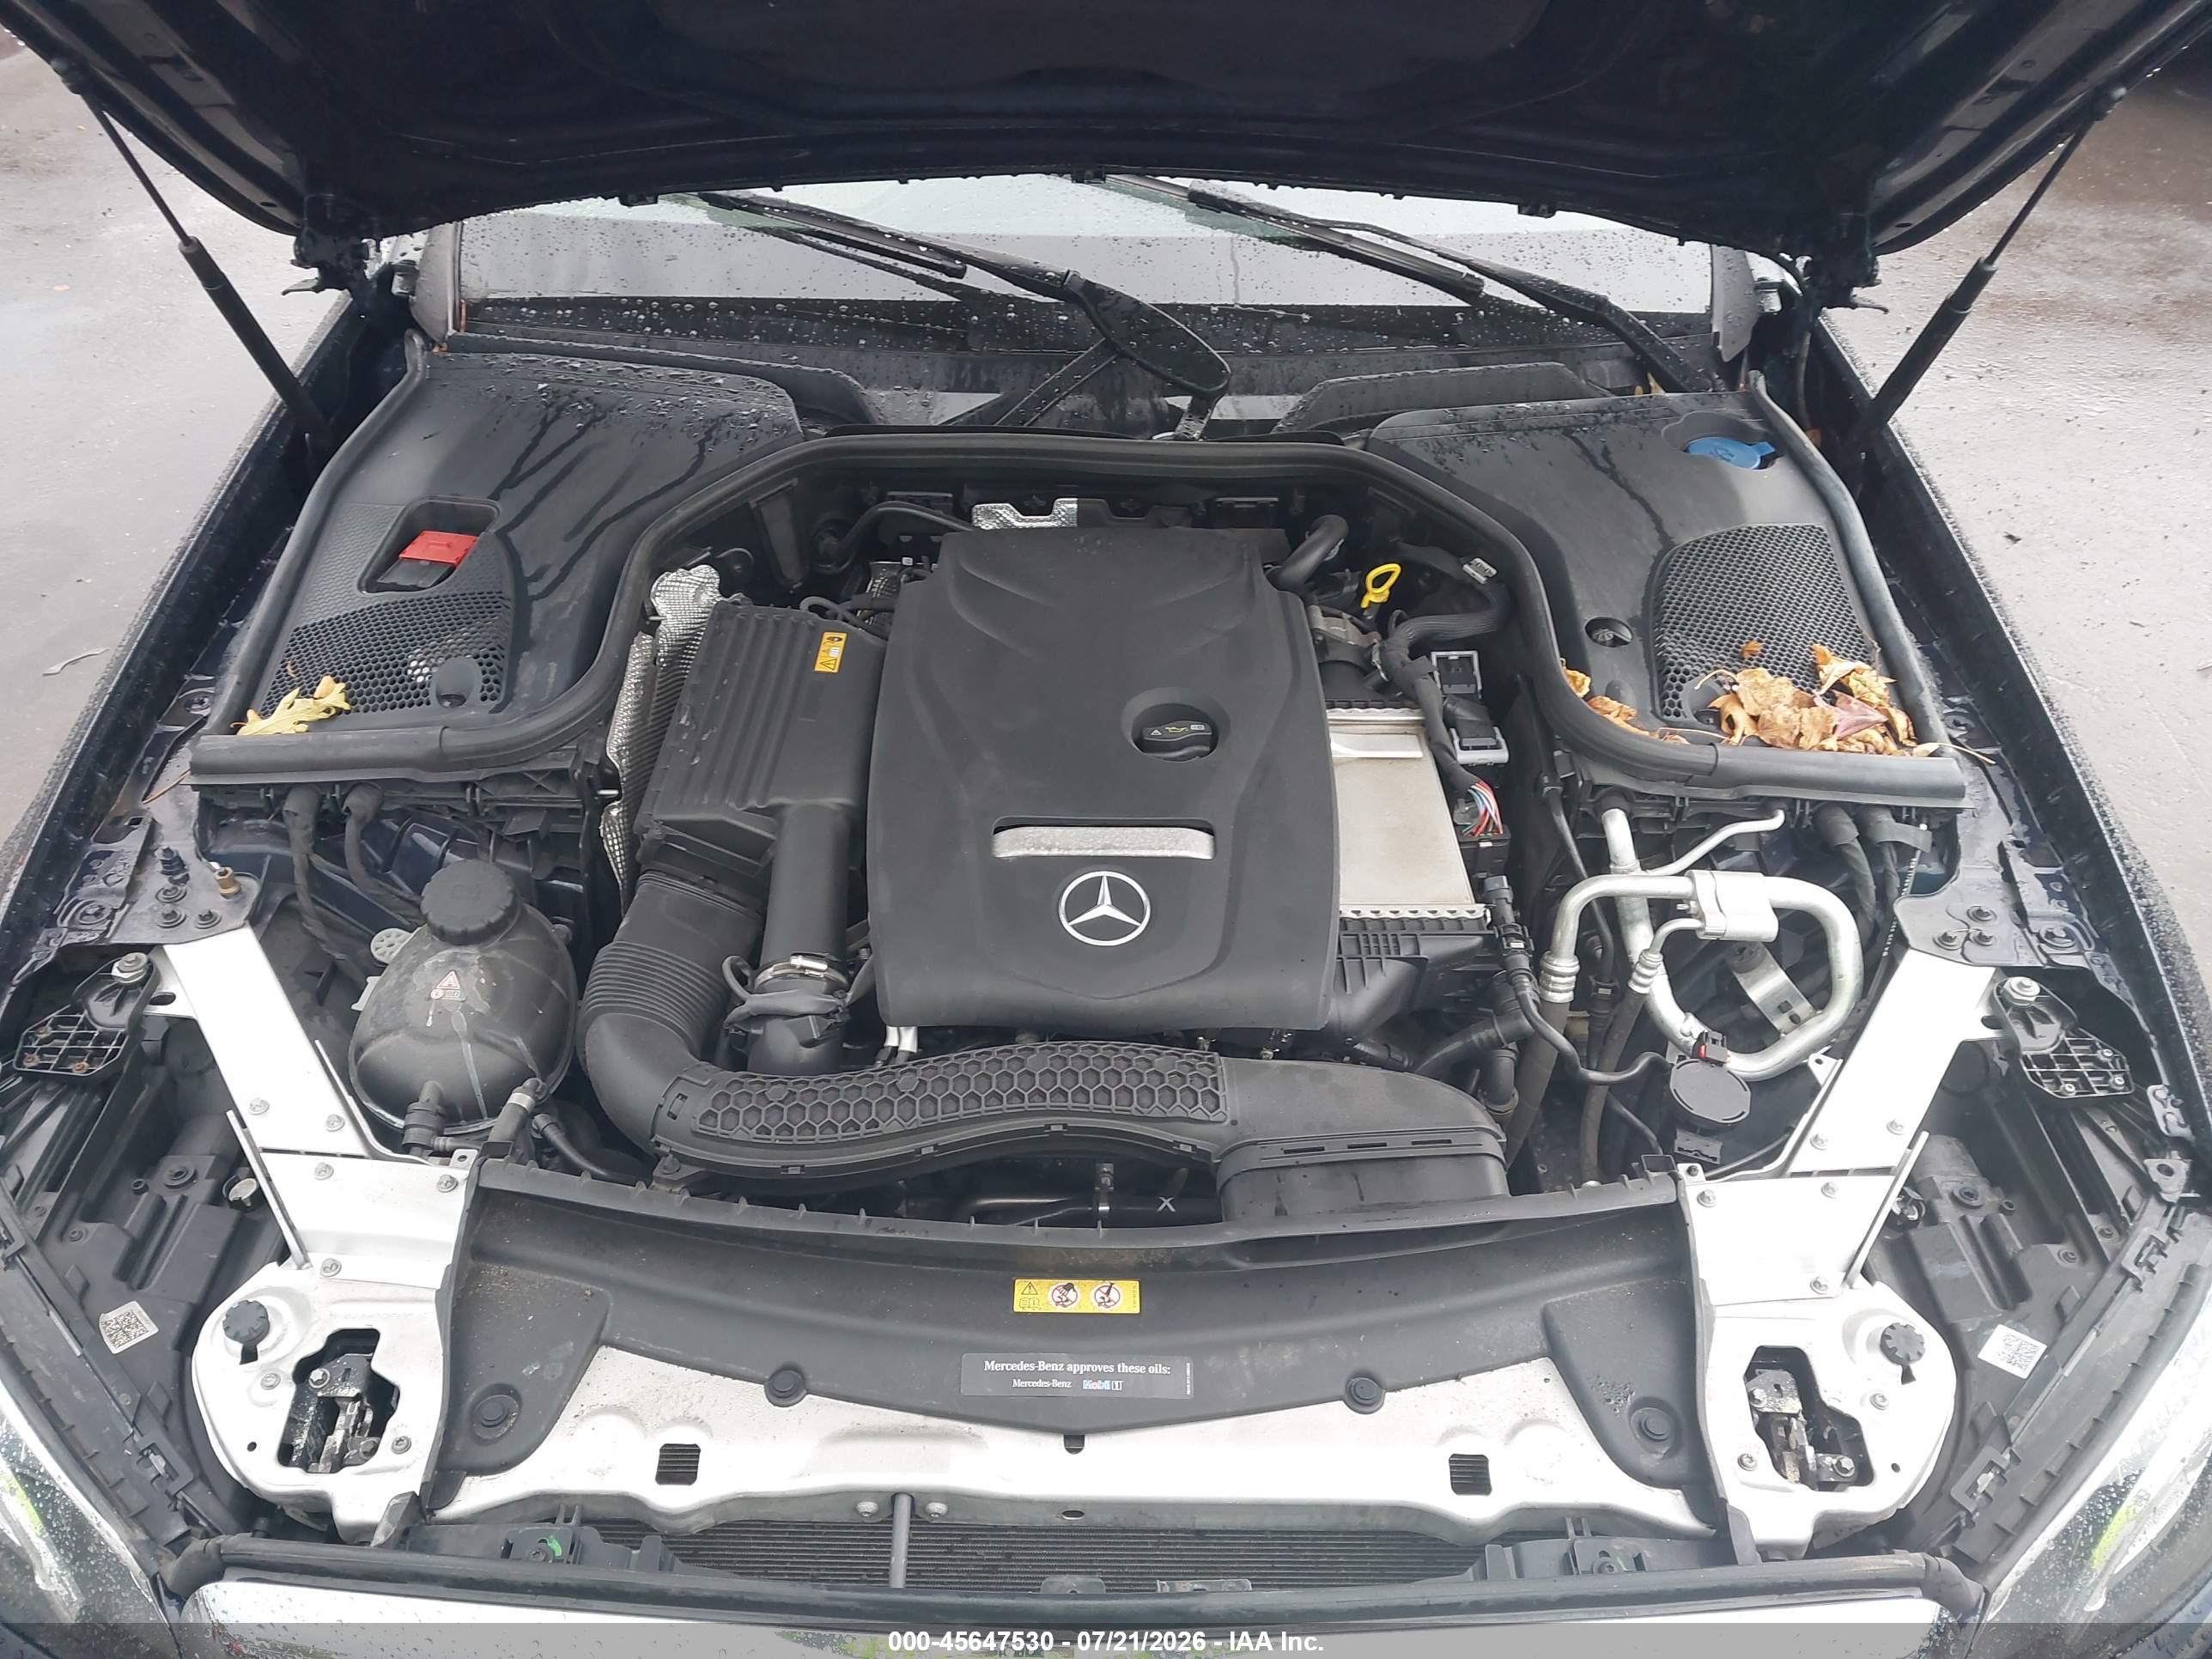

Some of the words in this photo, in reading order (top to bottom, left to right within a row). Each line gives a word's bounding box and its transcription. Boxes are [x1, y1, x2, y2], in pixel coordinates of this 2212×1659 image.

[983, 1359, 1065, 1373] Mercedes-Benz
[1066, 1362, 1115, 1375] approves
[1117, 1361, 1146, 1374] these
[1148, 1363, 1171, 1375] oils:
[1012, 1378, 1073, 1389] Mercedes-Benz
